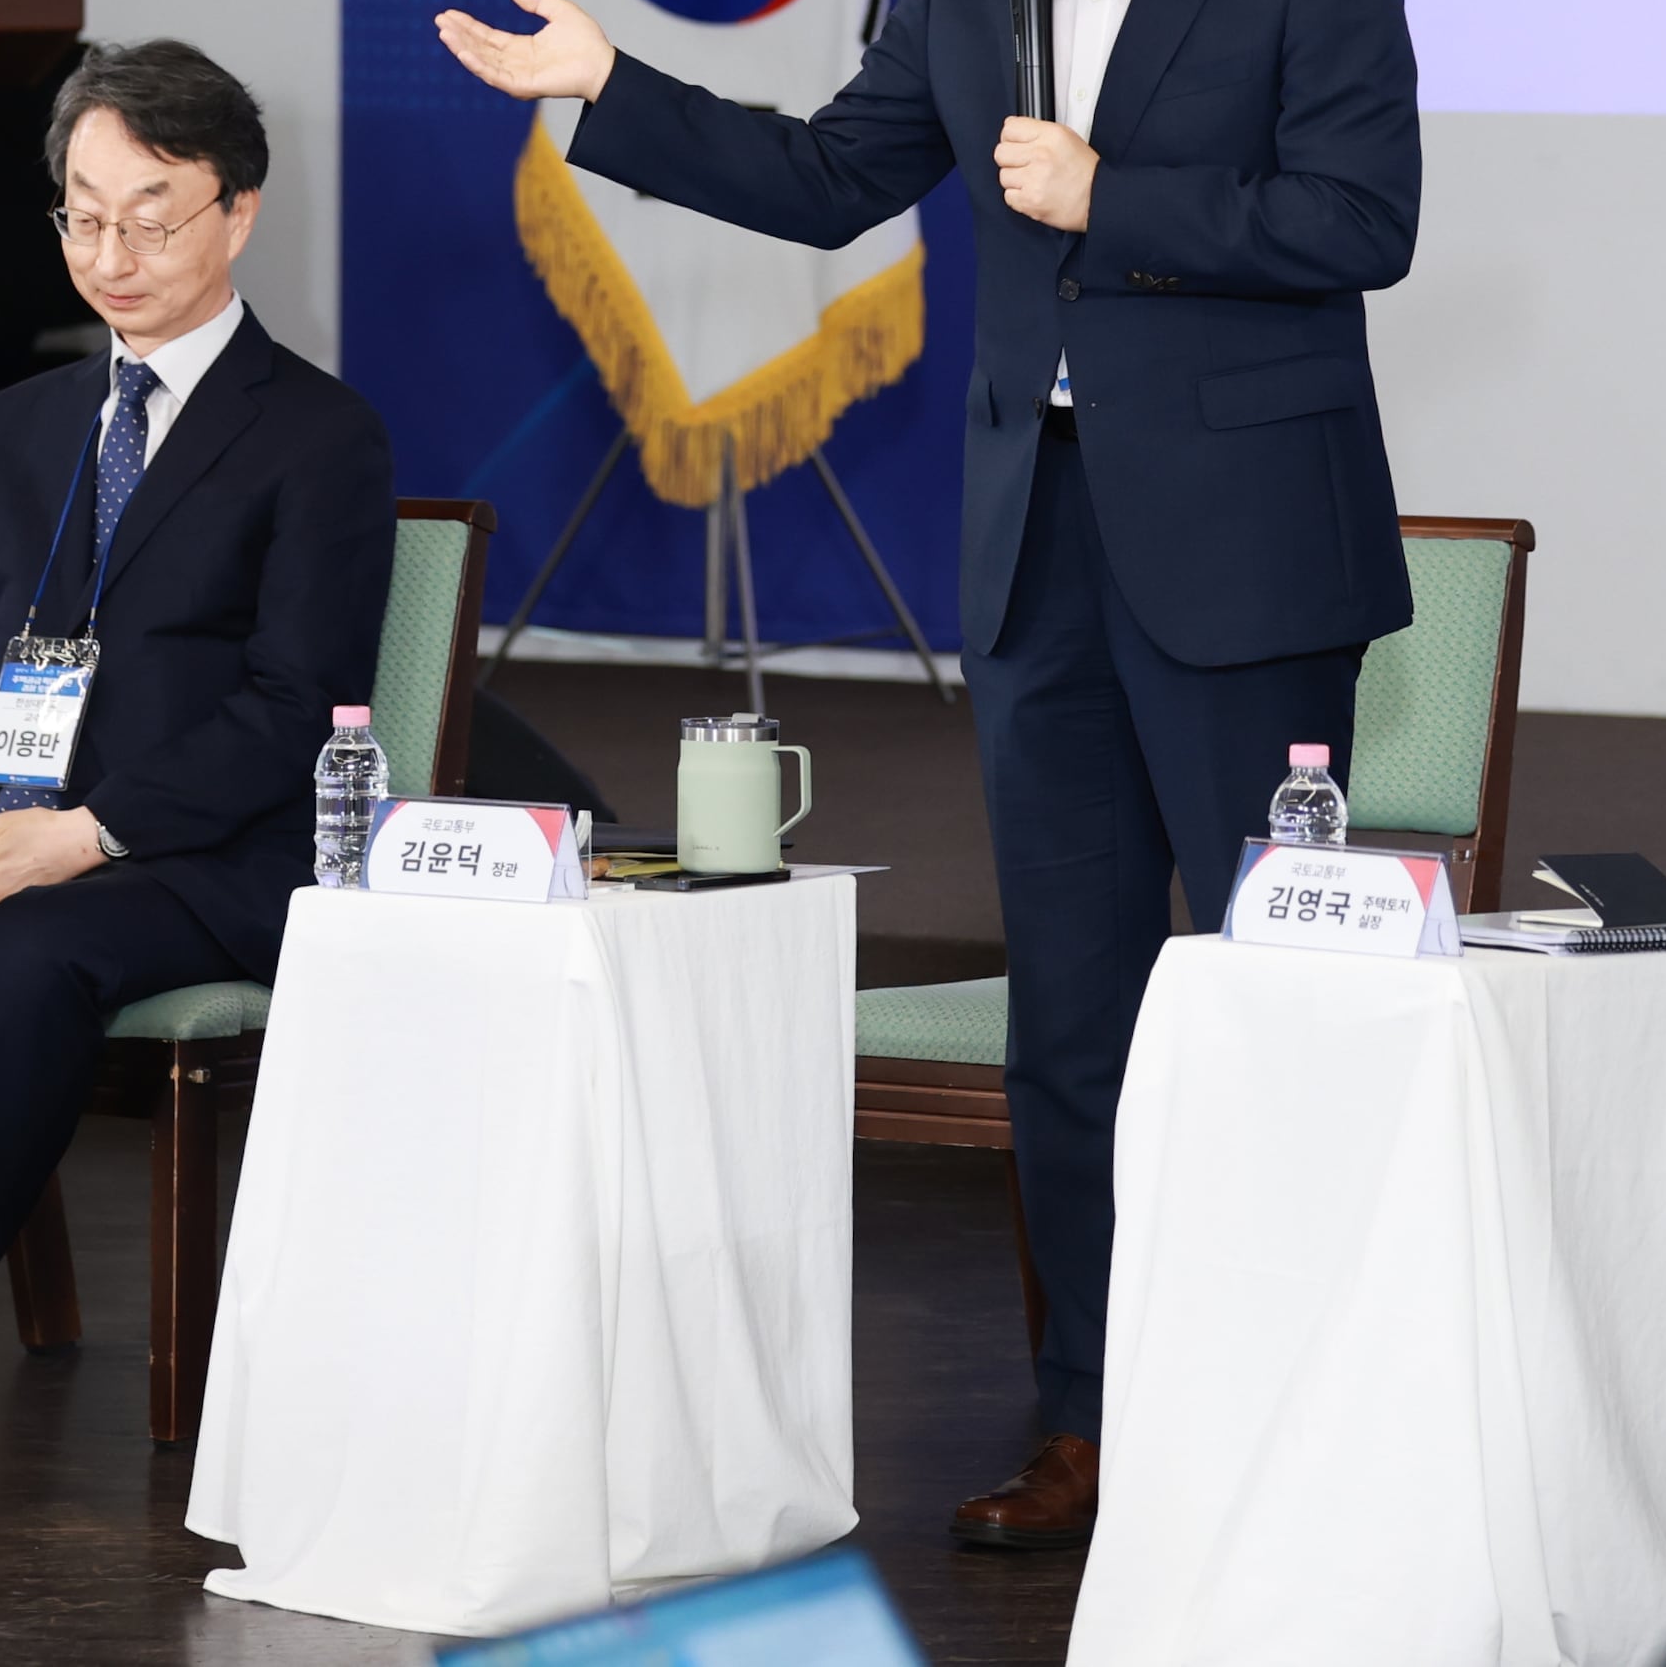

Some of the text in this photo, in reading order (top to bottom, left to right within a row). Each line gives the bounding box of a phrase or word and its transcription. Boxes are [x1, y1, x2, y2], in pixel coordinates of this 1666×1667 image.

[422, 818, 475, 834] 국토교통부
[401, 840, 518, 878] 김윤덕 장관
[1291, 861, 1346, 880] 국토교통부
[1268, 886, 1411, 925] 김영국 주택토지
[1358, 914, 1382, 930] 실장
